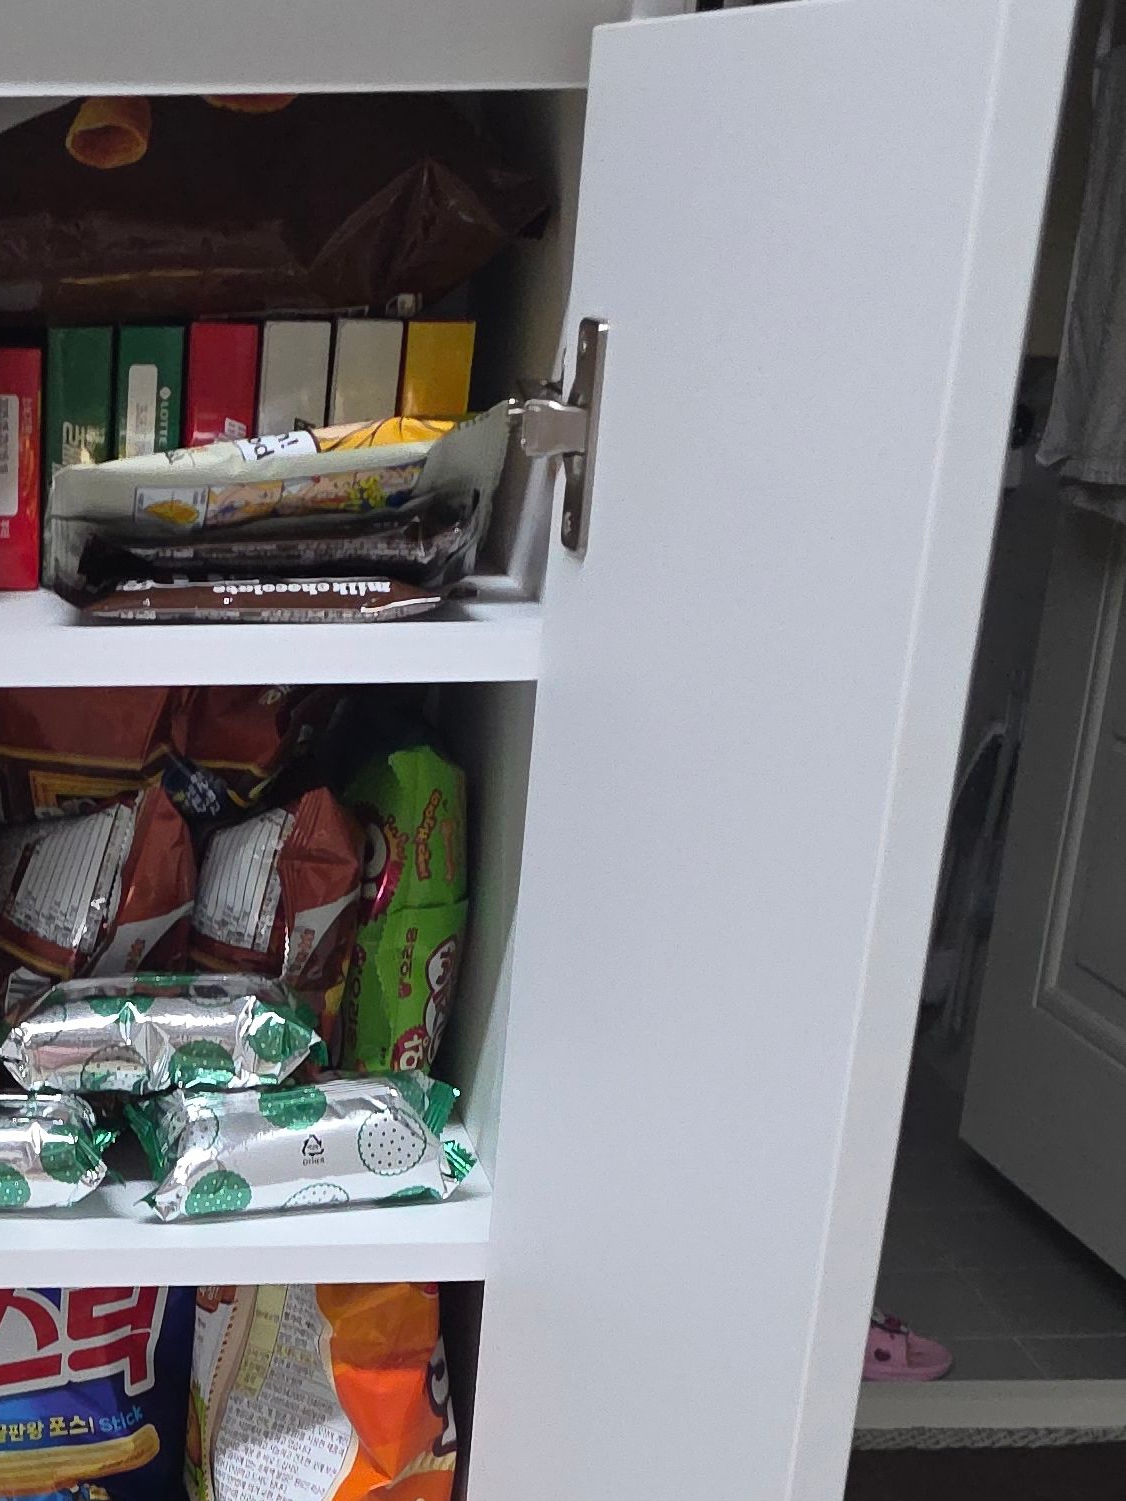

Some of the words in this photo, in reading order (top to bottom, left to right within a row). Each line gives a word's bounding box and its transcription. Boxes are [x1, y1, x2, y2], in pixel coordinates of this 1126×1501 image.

[158, 401, 170, 447] LOTTE
[332, 580, 392, 594] milk
[98, 1405, 144, 1433] Stick
